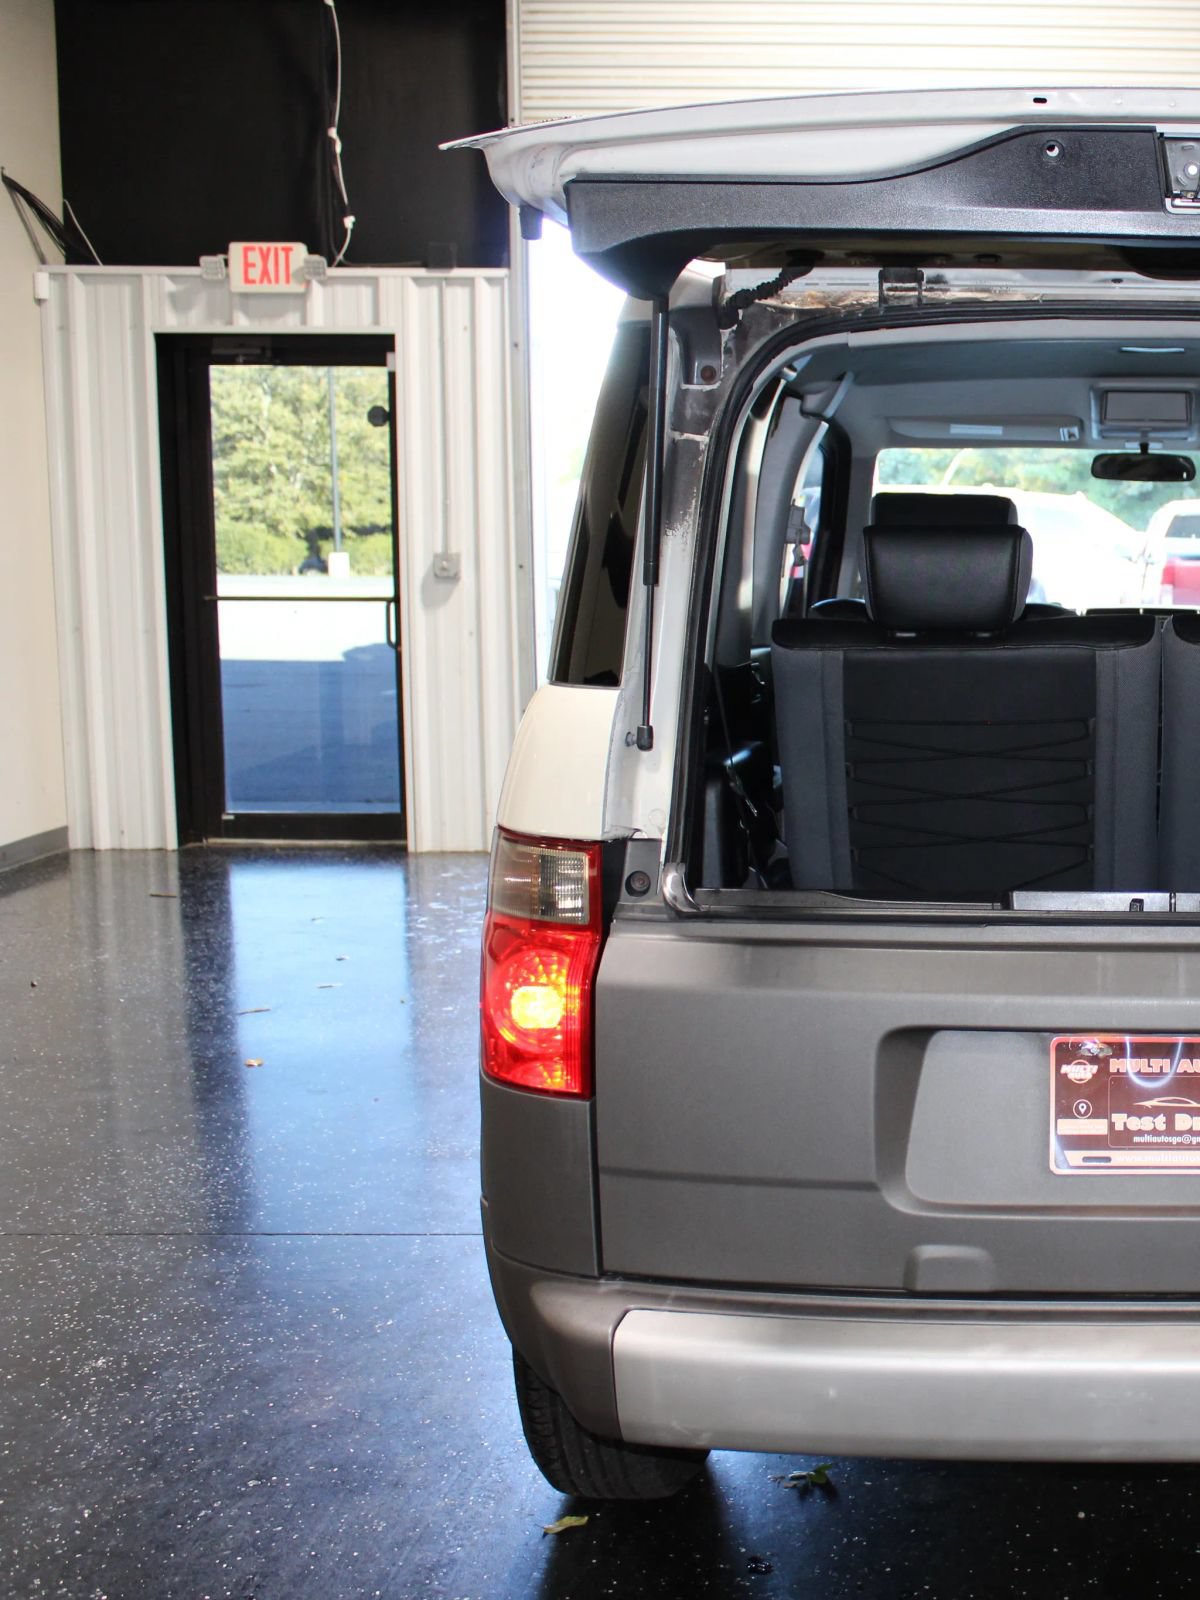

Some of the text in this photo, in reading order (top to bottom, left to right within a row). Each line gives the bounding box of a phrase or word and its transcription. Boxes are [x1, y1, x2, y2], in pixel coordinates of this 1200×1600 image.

[242, 246, 294, 285] EXIT
[1109, 1058, 1171, 1073] MULTI
[1111, 1113, 1166, 1131] Test
